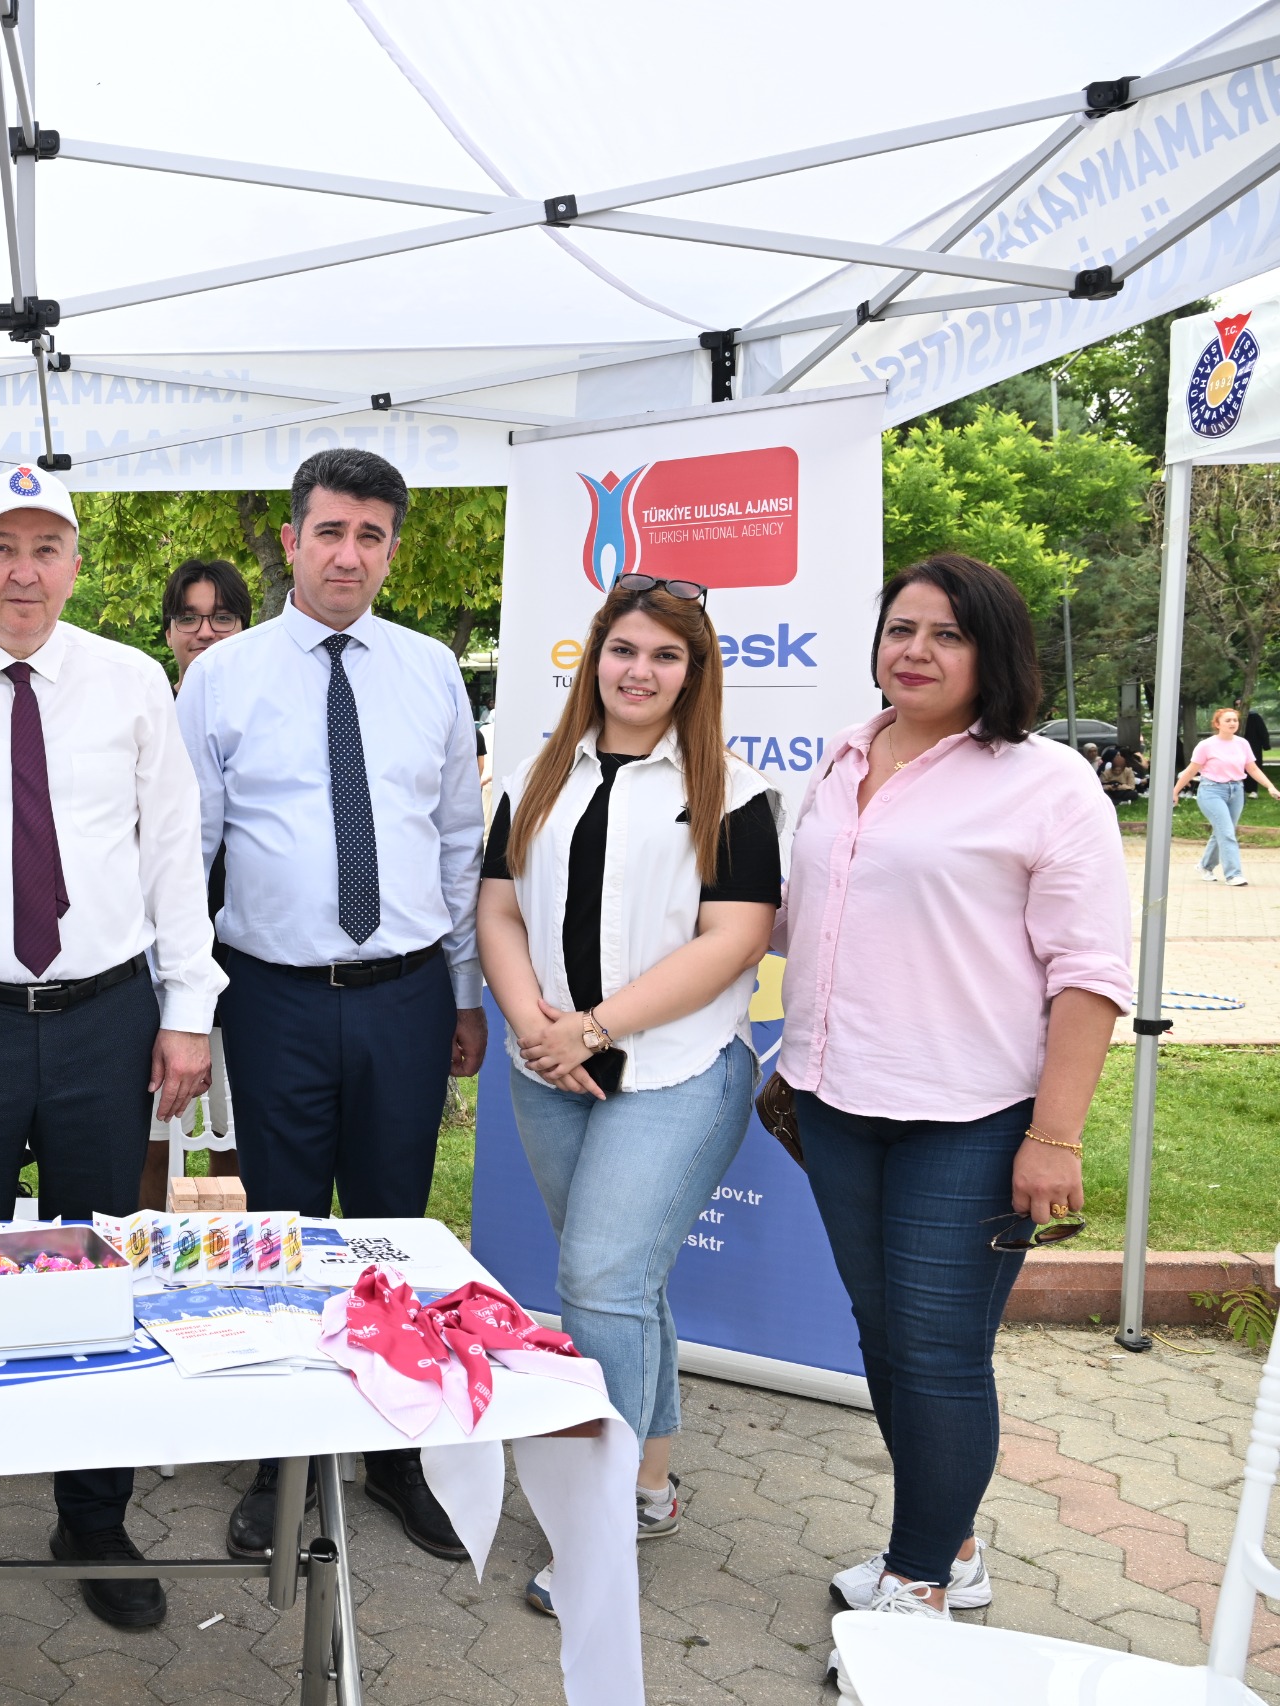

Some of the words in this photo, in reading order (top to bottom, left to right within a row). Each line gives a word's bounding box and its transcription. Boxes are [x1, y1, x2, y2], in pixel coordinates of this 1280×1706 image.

[1209, 375, 1232, 391] 1992
[642, 505, 692, 523] TÜRKİYE
[694, 501, 742, 519] ULUSAL
[745, 497, 793, 514] AJANSI
[649, 530, 689, 545] TURKISH
[692, 526, 738, 541] NATIONAL
[741, 522, 784, 537] AGENCY
